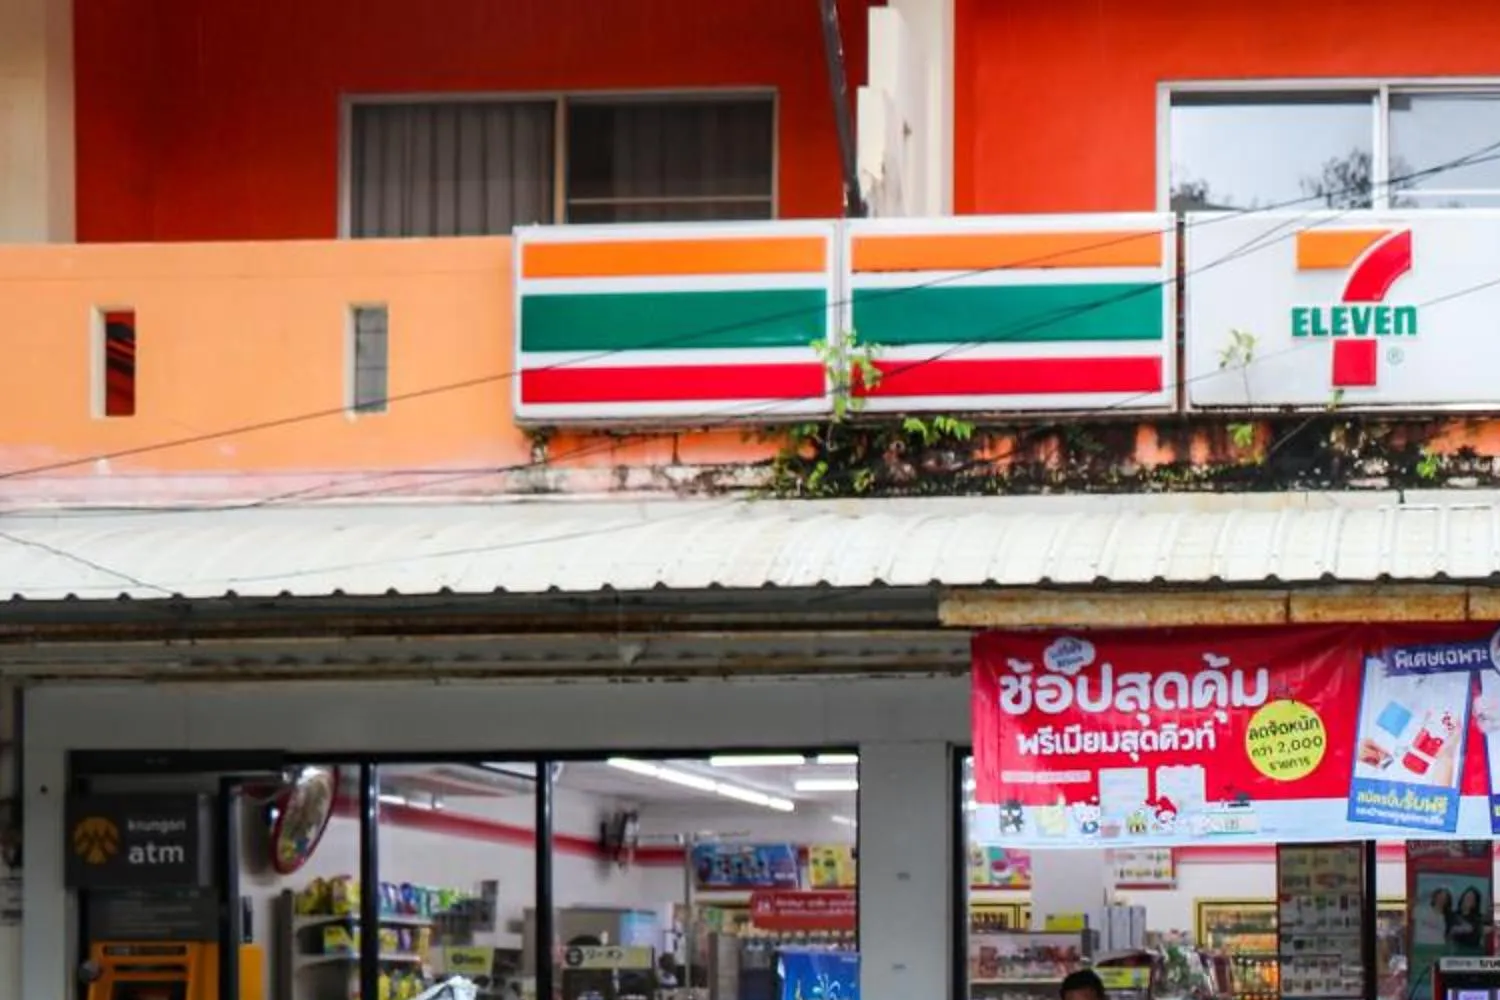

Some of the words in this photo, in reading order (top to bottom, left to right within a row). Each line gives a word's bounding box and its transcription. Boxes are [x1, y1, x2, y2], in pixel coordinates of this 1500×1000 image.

[999, 652, 1269, 727] ช้อปสุดคุ้ม
[1277, 735, 1323, 754] 2,000
[128, 842, 185, 865] atm
